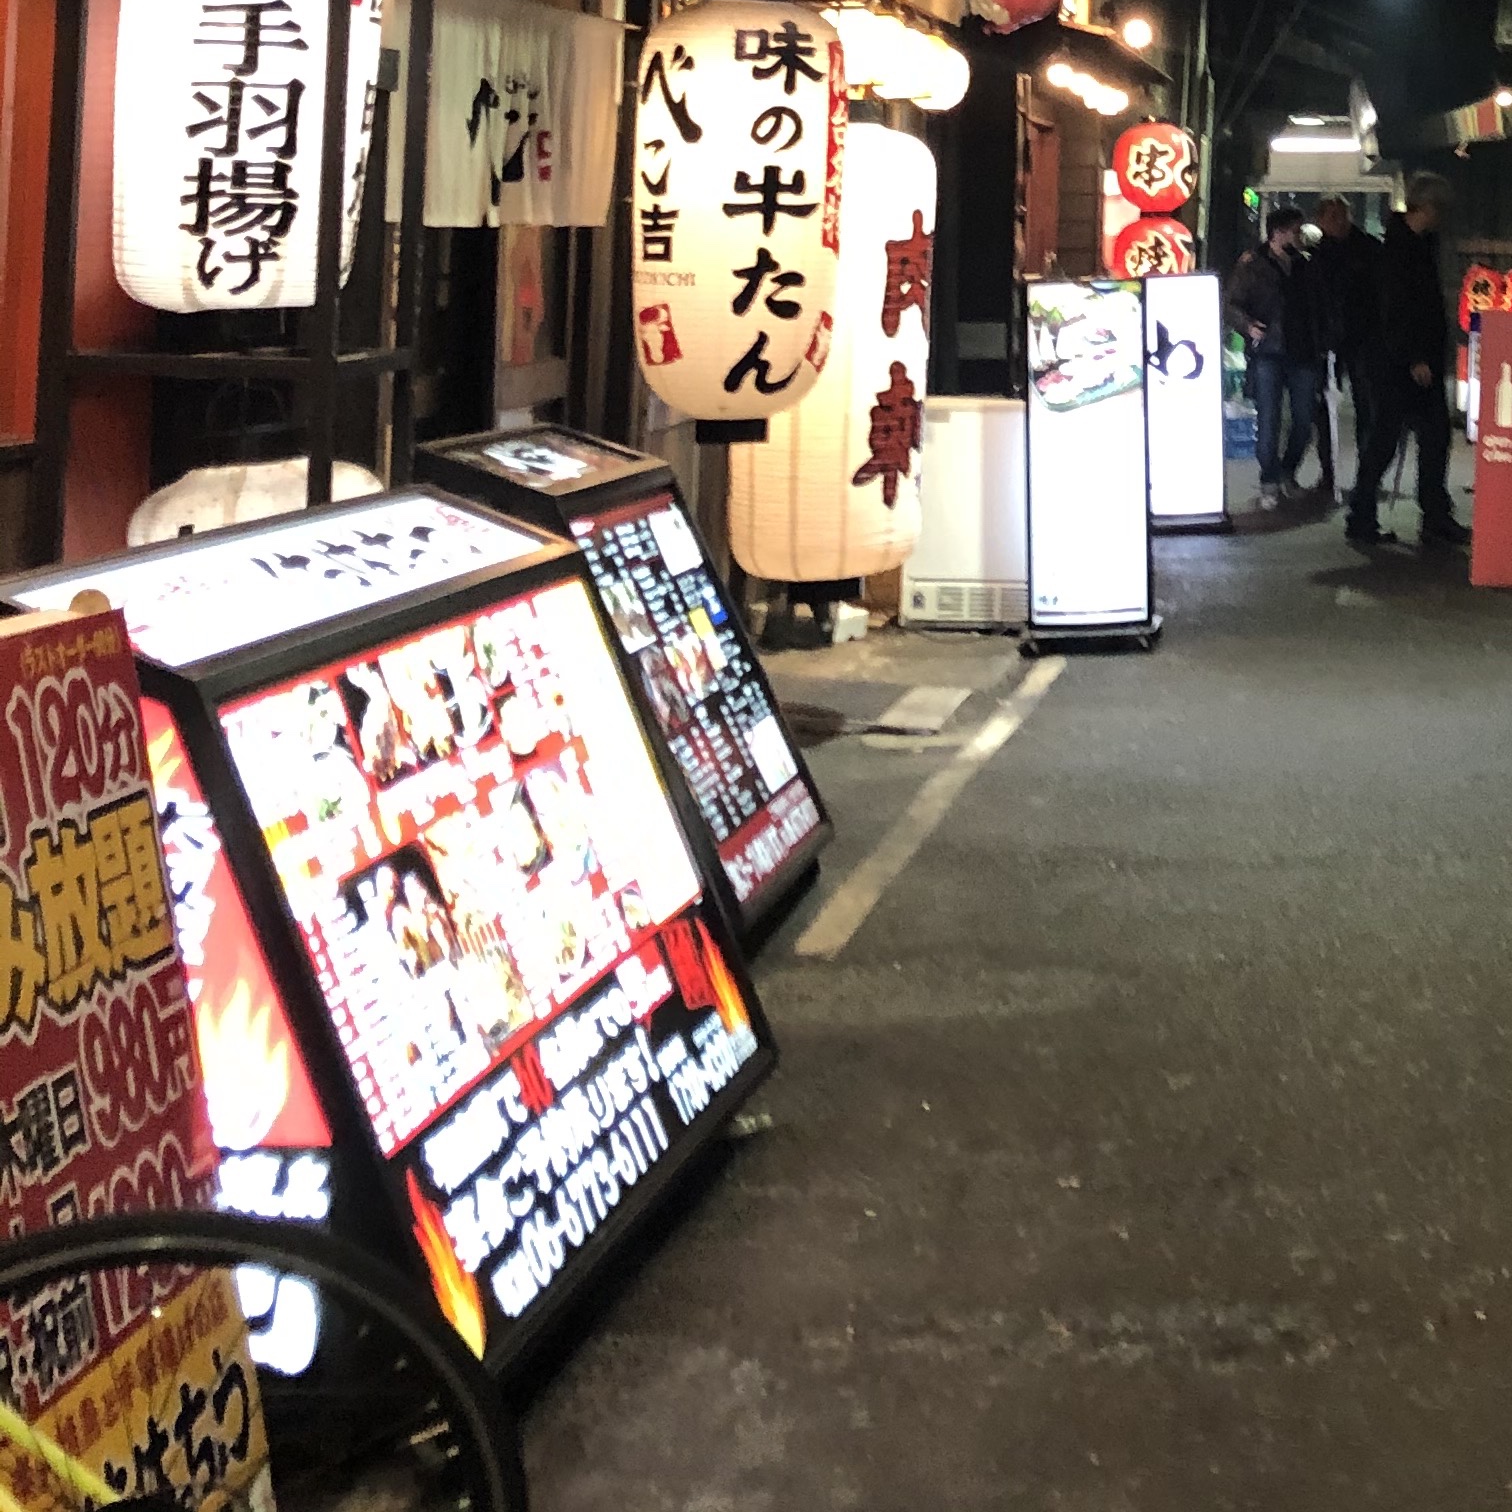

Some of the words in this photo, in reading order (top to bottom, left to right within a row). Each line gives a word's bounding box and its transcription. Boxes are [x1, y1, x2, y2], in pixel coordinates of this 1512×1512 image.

[640, 44, 702, 263] べこ吉
[722, 20, 826, 394] 味の牛たん
